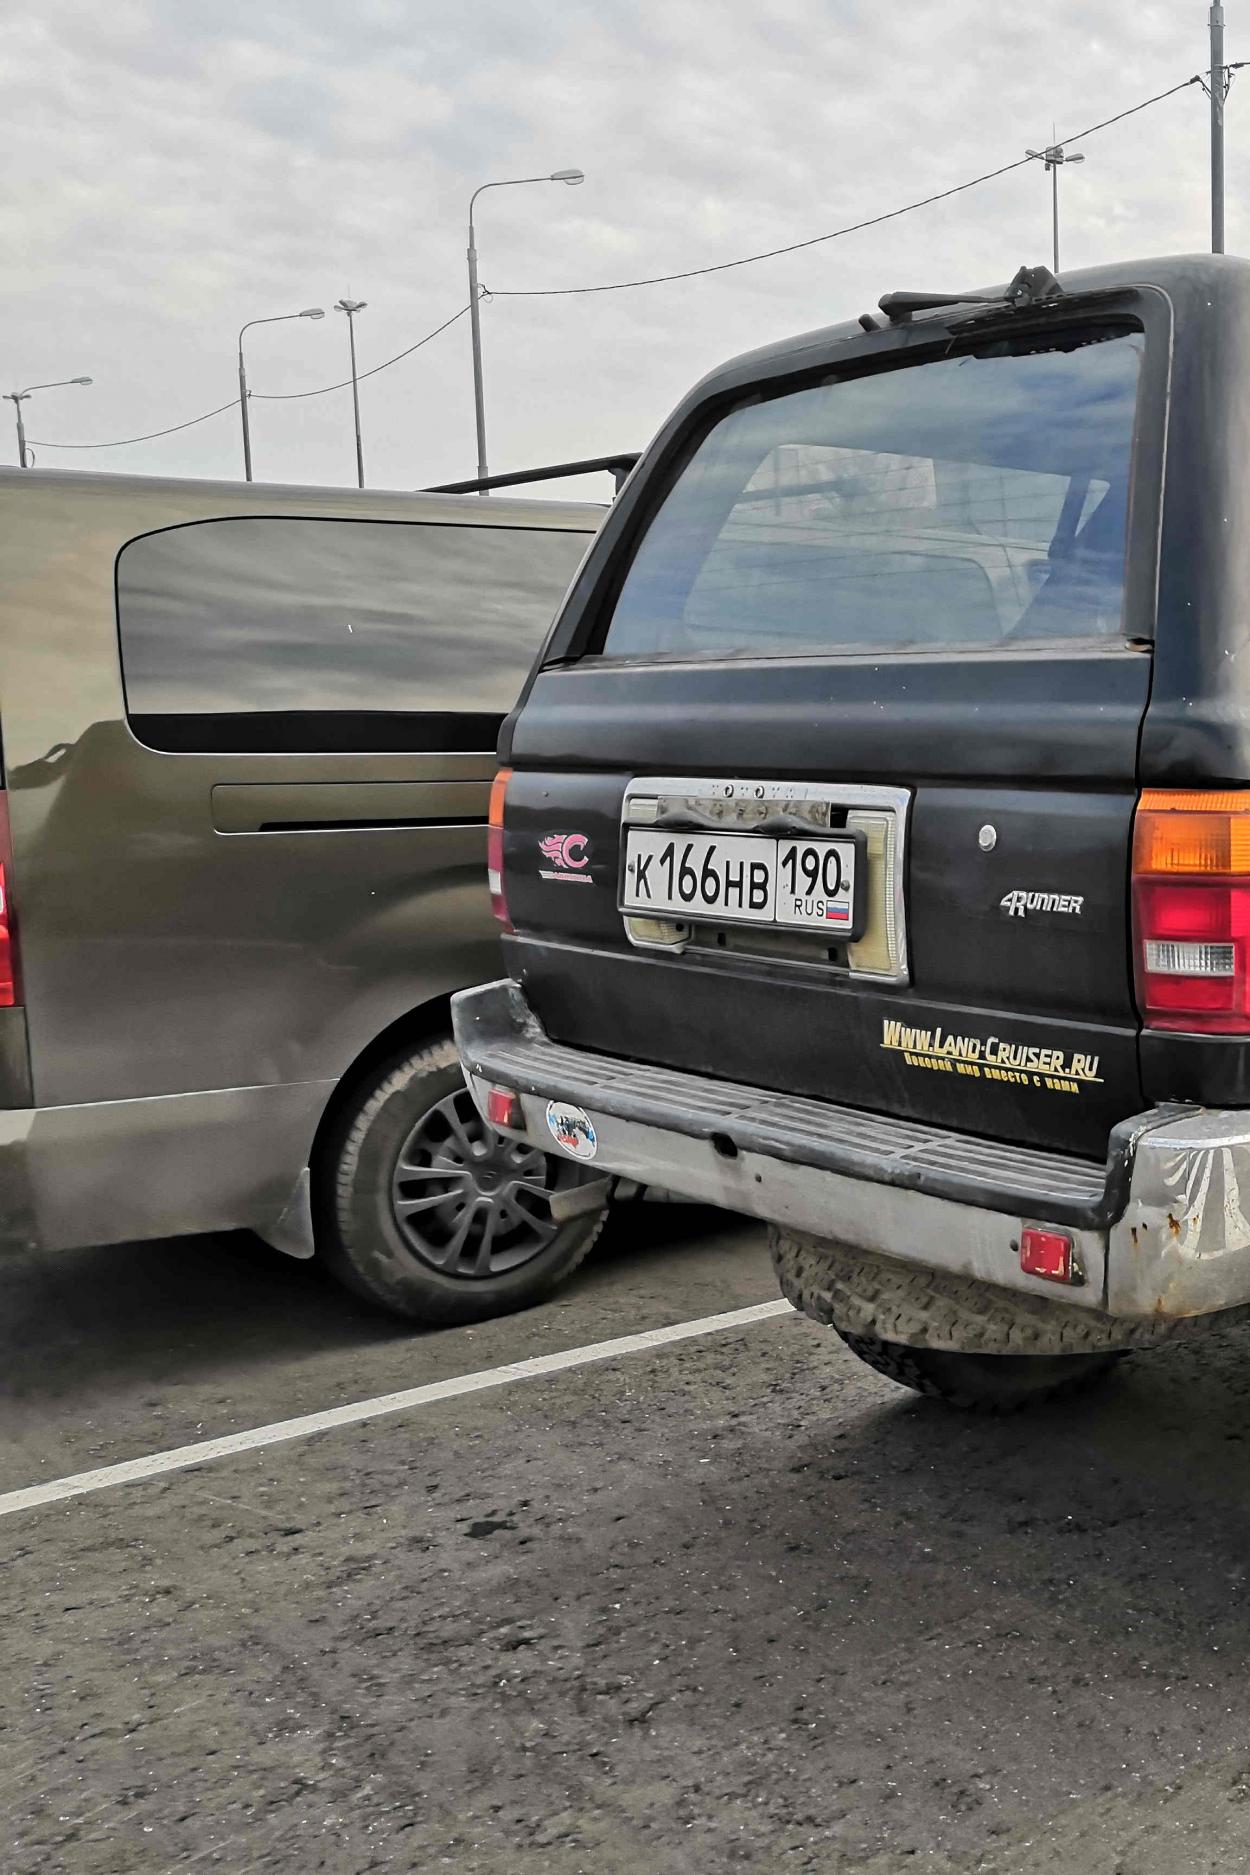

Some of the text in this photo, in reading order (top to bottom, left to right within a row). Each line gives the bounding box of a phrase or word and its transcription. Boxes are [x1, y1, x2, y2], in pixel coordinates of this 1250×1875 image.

[636, 842, 842, 909] К166НВ 190
[794, 898, 825, 918] RUS
